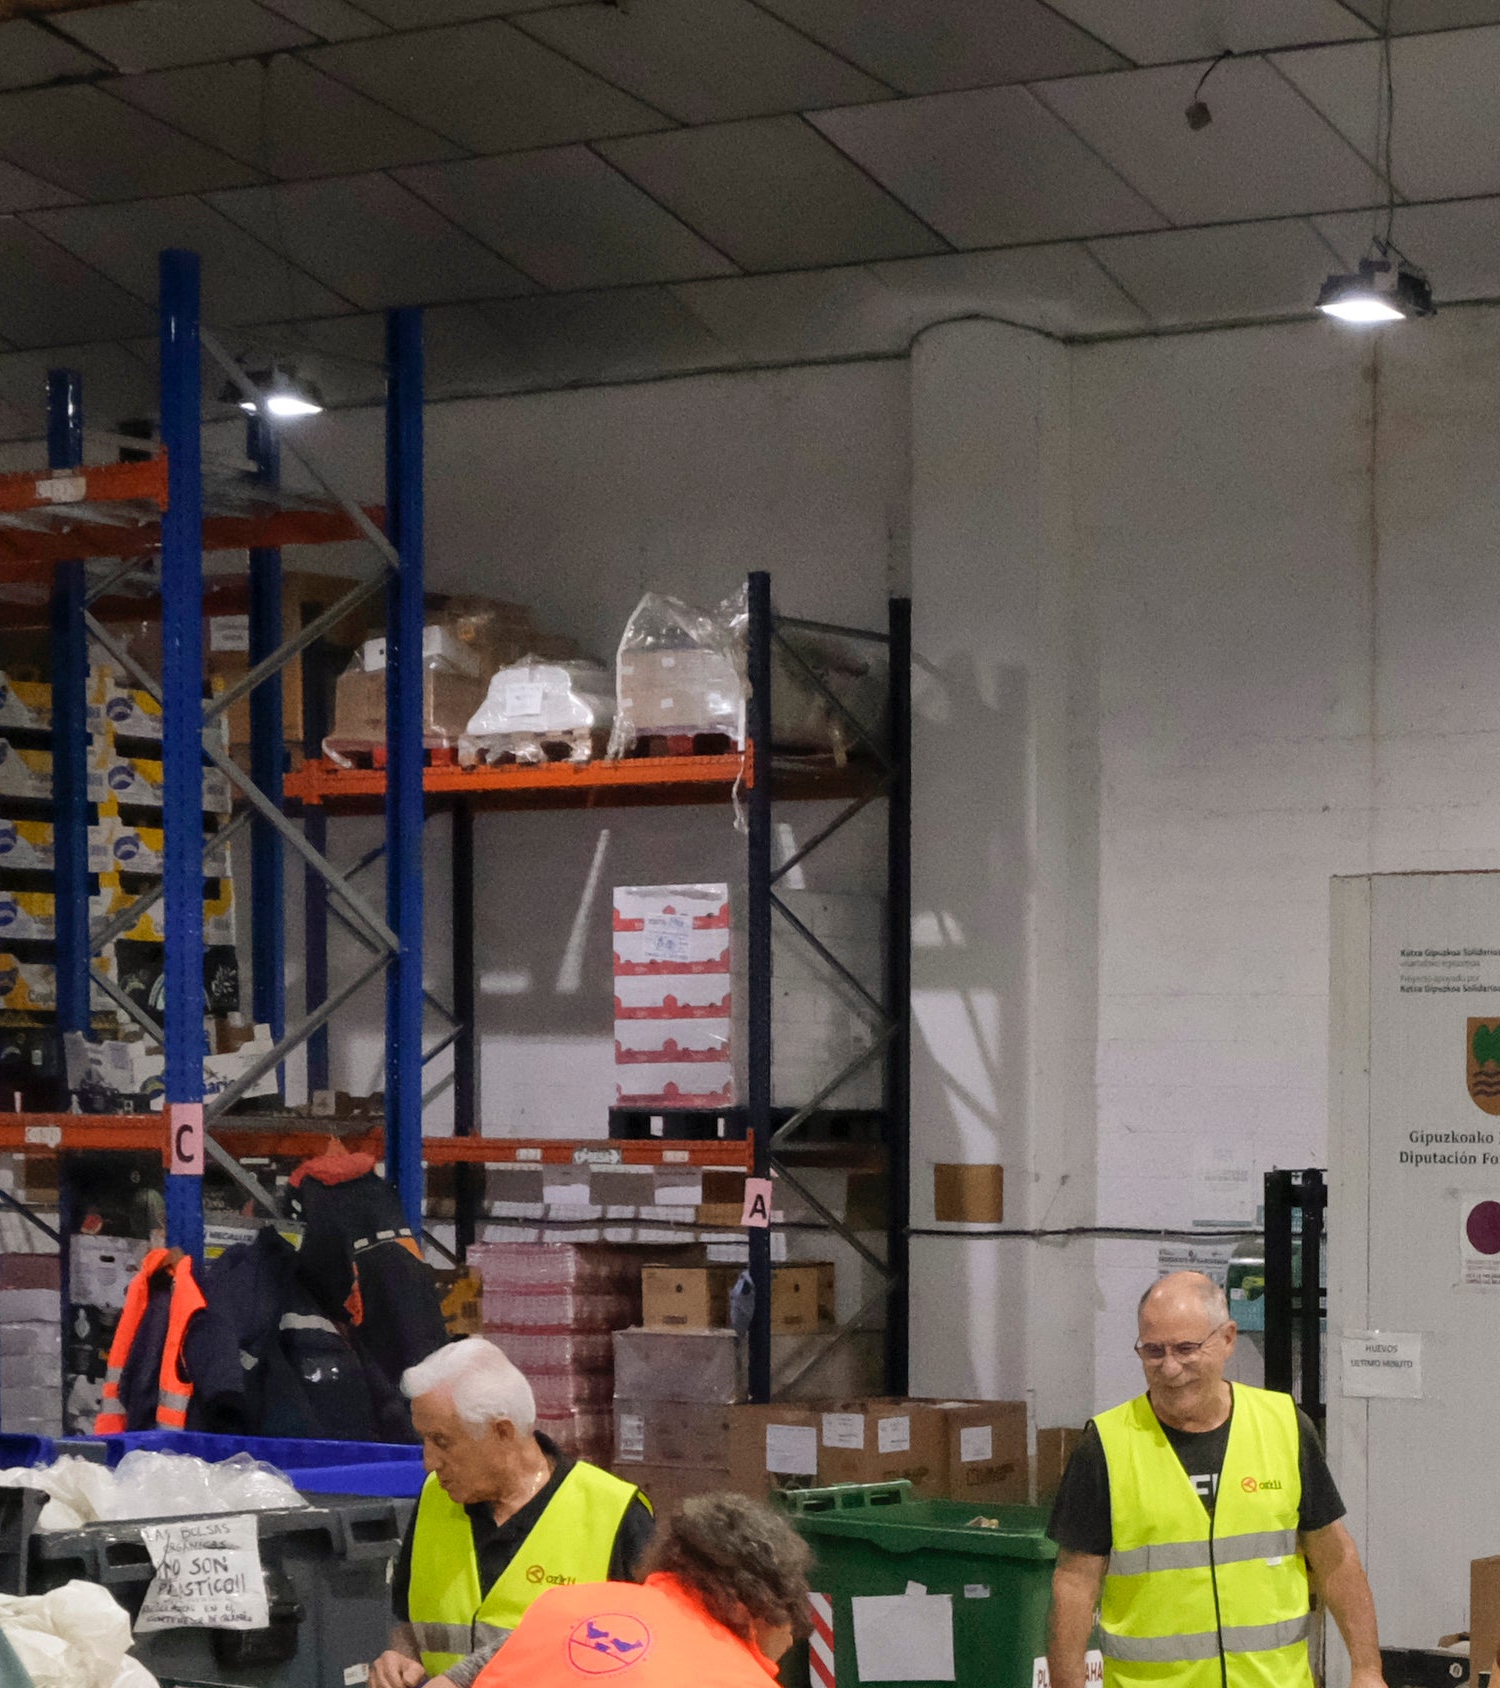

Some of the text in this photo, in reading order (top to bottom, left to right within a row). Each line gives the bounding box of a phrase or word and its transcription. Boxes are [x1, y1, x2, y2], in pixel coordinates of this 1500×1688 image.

[175, 1124, 194, 1163] C
[1409, 1131, 1494, 1147] Gipuzkoako
[1399, 1151, 1477, 1167] Diputación
[749, 1193, 767, 1219] A
[1365, 1344, 1398, 1353] HUEVOS
[189, 1556, 228, 1576] SON
